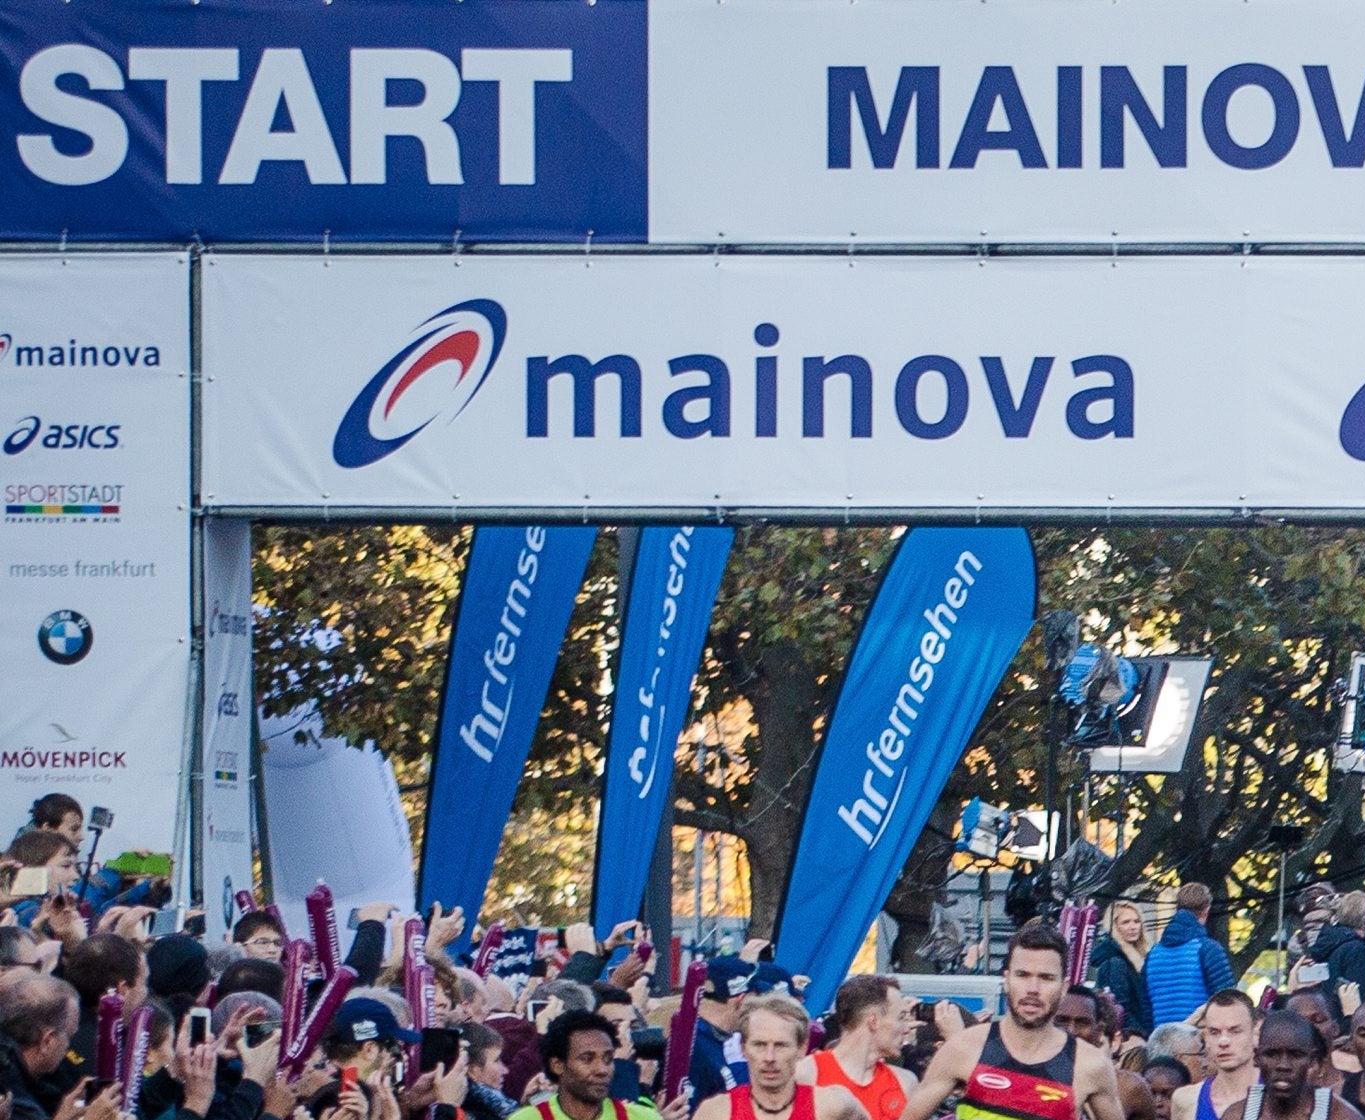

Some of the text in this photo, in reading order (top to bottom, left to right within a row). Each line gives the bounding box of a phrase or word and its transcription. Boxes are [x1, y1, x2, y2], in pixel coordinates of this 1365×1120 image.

[16, 43, 574, 187] START
[15, 338, 161, 367] mainova
[526, 322, 1136, 440] mainova
[5, 484, 125, 503] SPORTSTADT
[9, 559, 157, 578] messe frankfurt
